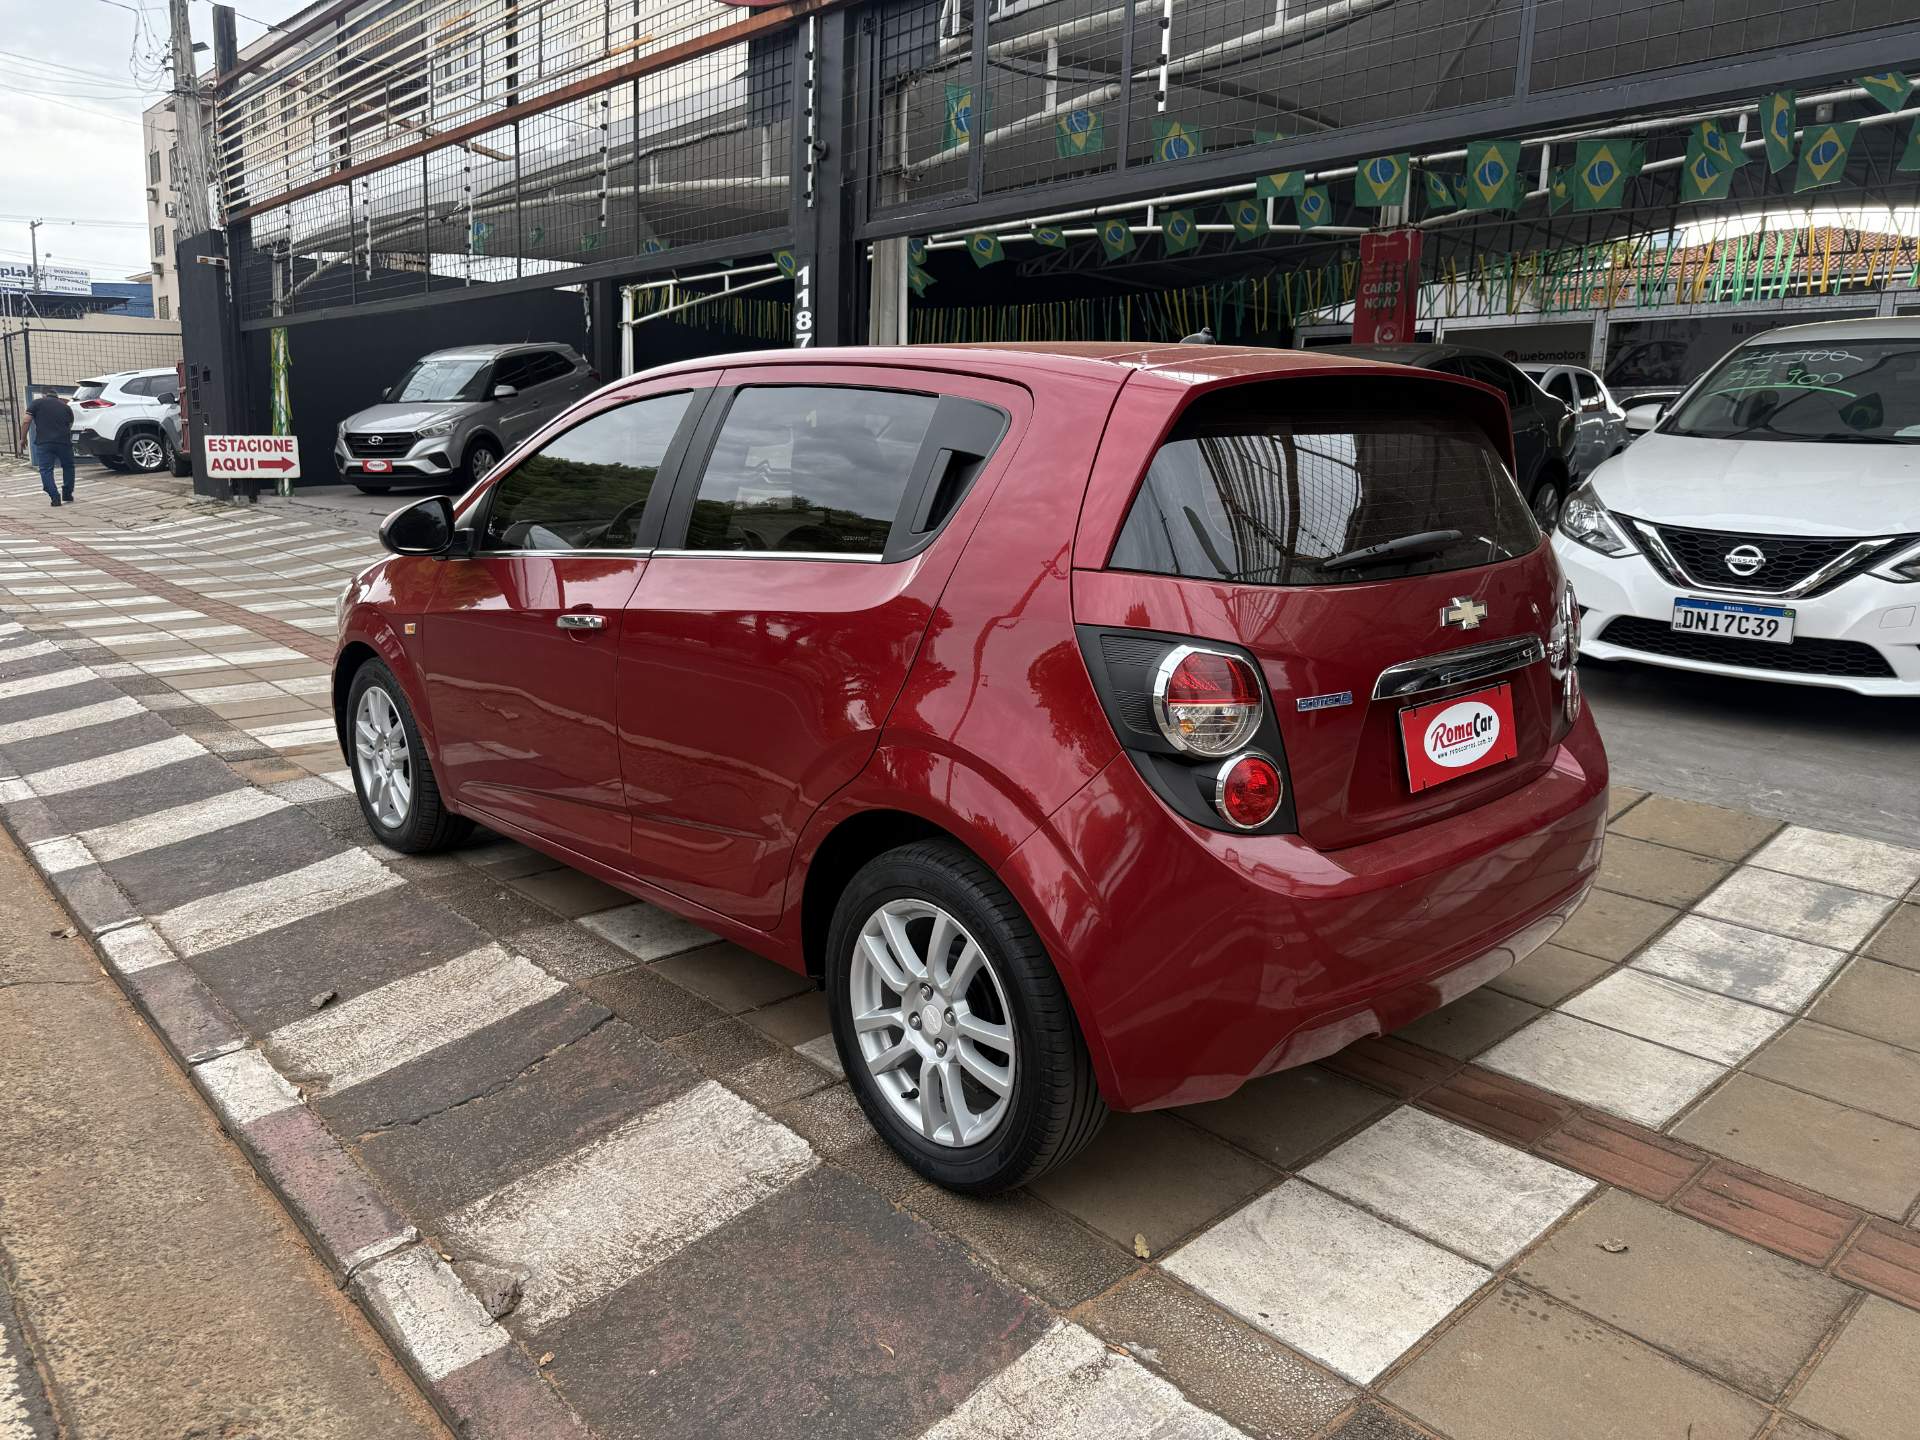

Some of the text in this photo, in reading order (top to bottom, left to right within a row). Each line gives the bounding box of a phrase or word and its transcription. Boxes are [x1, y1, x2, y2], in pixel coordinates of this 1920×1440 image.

[1363, 282, 1401, 295] CARRO
[1520, 349, 1586, 361] webmotors
[208, 439, 294, 453] ESTACIONE
[211, 457, 256, 472] AQUI
[1730, 556, 1760, 565] NISSAN
[1682, 609, 1780, 638] DNI7C39
[1431, 712, 1493, 752] RomaCar
